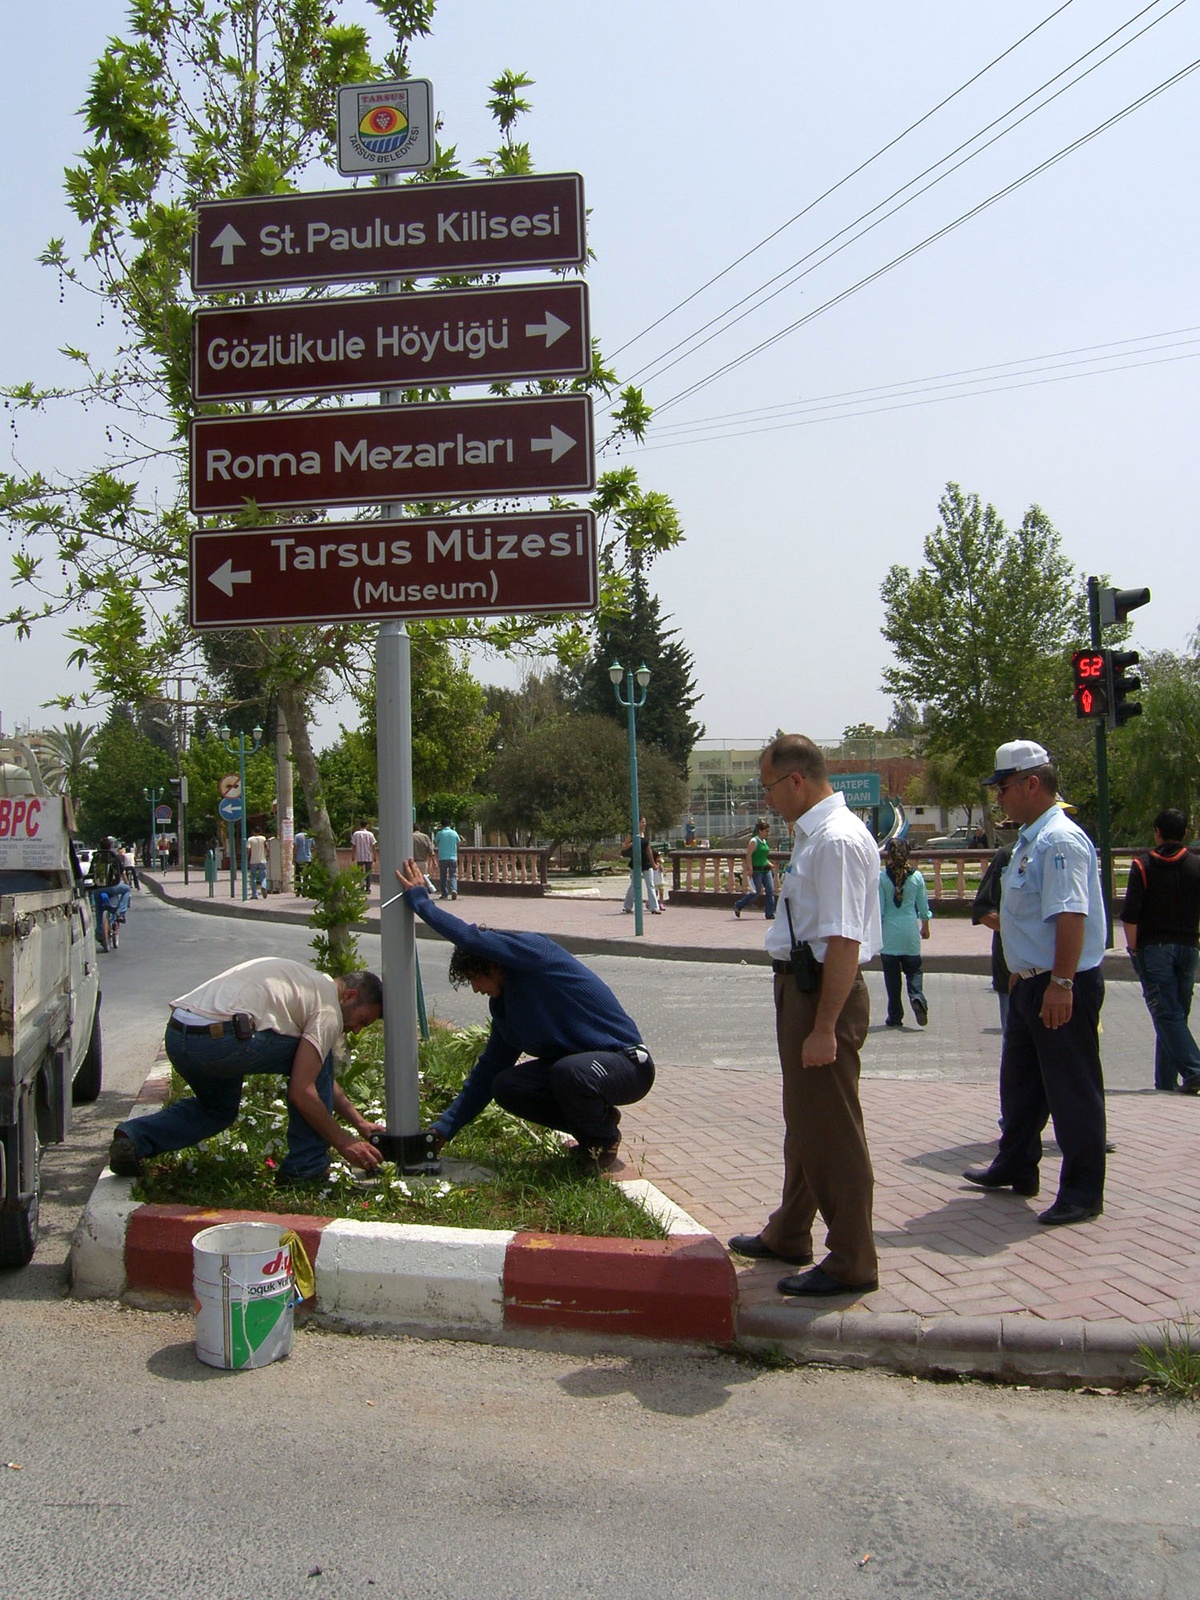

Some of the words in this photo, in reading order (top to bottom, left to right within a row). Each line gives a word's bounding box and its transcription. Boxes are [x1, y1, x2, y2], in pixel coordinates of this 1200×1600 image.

[361, 91, 404, 103] TARSUS
[349, 132, 376, 162] TARSUS
[259, 224, 301, 257] St.
[307, 218, 426, 253] Paulus
[437, 206, 560, 244] Kilisesi
[207, 330, 366, 371] Gözlükule
[376, 319, 509, 363] Höyüğü
[206, 449, 321, 482] Roma
[334, 434, 514, 473] Mezarları
[271, 538, 413, 572] Tarsus
[427, 524, 583, 563] Müzesi
[353, 569, 499, 610] (Museum)
[1079, 656, 1103, 678] 52
[845, 791, 871, 801] DANI
[0, 798, 42, 837] BPC
